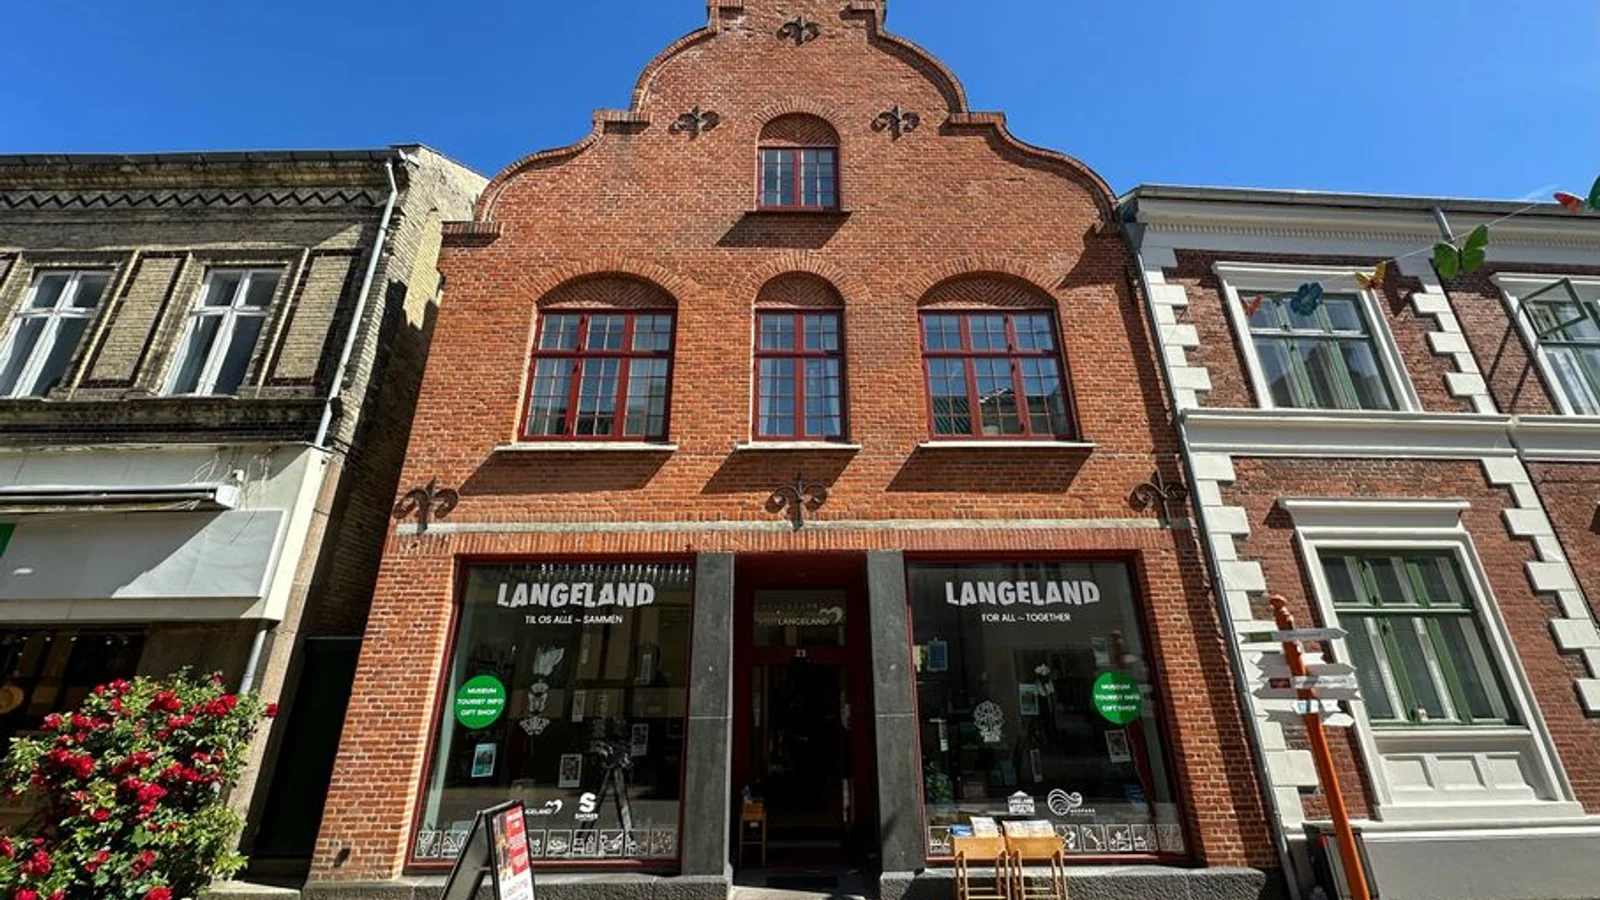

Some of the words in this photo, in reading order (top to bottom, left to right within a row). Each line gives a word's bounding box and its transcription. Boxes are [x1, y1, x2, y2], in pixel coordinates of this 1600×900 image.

[497, 582, 655, 608] LANGELAND
[945, 580, 1100, 606] LANGELAND
[525, 615, 537, 624] TIL
[538, 615, 552, 624] OS
[553, 614, 573, 624] ALLE
[583, 614, 623, 624] SAMMEN
[981, 613, 999, 622] FOR
[1001, 613, 1016, 622] ALL
[1026, 612, 1071, 622] TOGETHER
